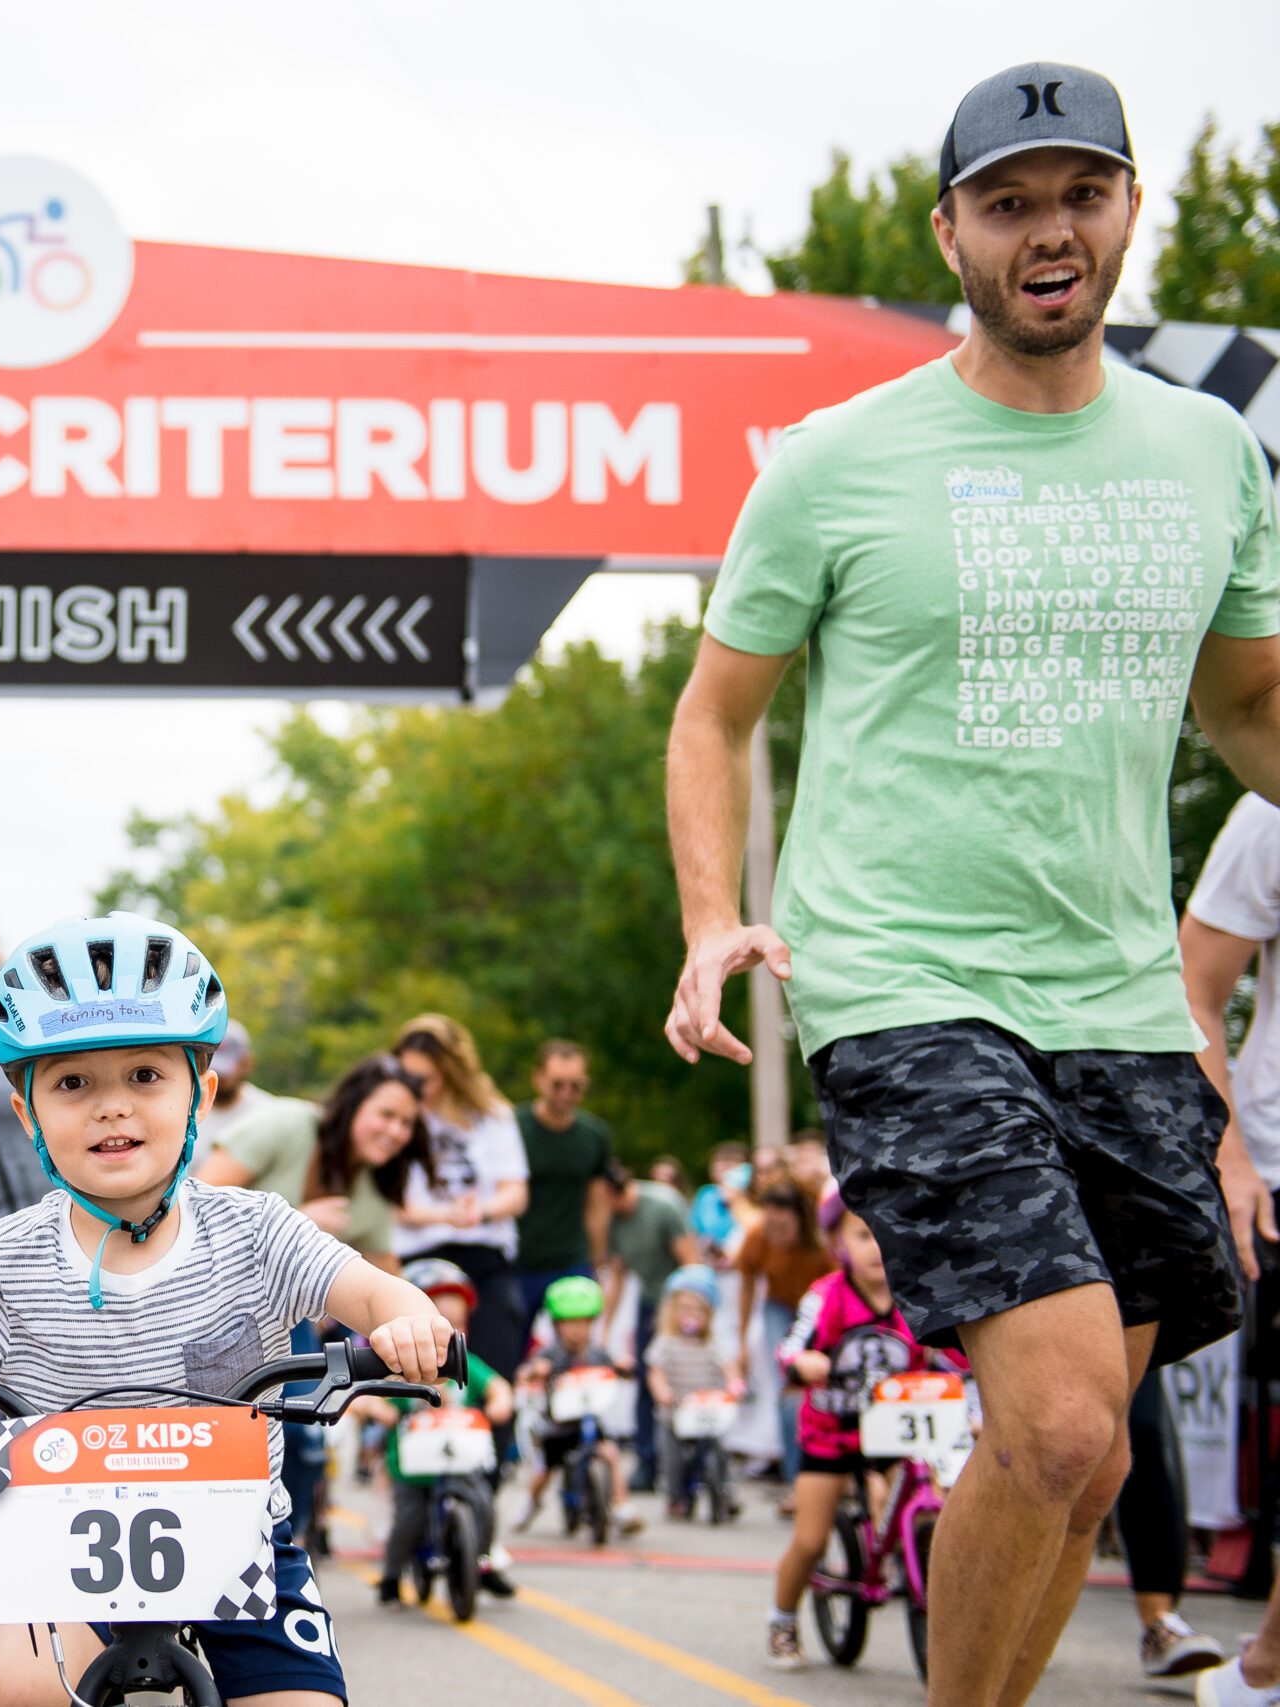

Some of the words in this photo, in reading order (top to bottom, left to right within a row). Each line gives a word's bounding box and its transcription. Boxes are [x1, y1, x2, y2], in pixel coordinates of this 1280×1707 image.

[976, 486, 1020, 498] TRAILS
[1039, 479, 1193, 503] ALL-AMERI-
[951, 507, 1008, 526] CAN
[1014, 503, 1101, 525] HEROS
[1117, 500, 1197, 520] BLOW-
[954, 526, 1018, 546] ING
[1044, 522, 1201, 545] SPRINGS
[956, 547, 1032, 568] LOOP
[1060, 544, 1141, 565] BOMB
[1151, 543, 1203, 563] DIG-
[958, 568, 1042, 590] GITY
[1091, 565, 1204, 587] OZONE
[986, 588, 1098, 611] PINYON
[1114, 587, 1194, 609] CREEK
[960, 613, 1035, 635] RAGO
[1052, 611, 1199, 632] RAZORBACK
[960, 635, 1065, 656] RIDGE
[1100, 633, 1181, 654] SBAT
[958, 657, 1082, 680] TAYLOR
[1101, 656, 1187, 677] HOME-
[957, 681, 1047, 702] STEAD
[1072, 679, 1121, 700] THE
[1131, 678, 1184, 698] BACK
[957, 704, 999, 725] 40
[1020, 703, 1104, 724] LOOP
[956, 727, 1063, 748] LEDGES
[82, 1424, 128, 1449] OZ
[901, 1413, 935, 1441] 31
[70, 1508, 185, 1594] 36
